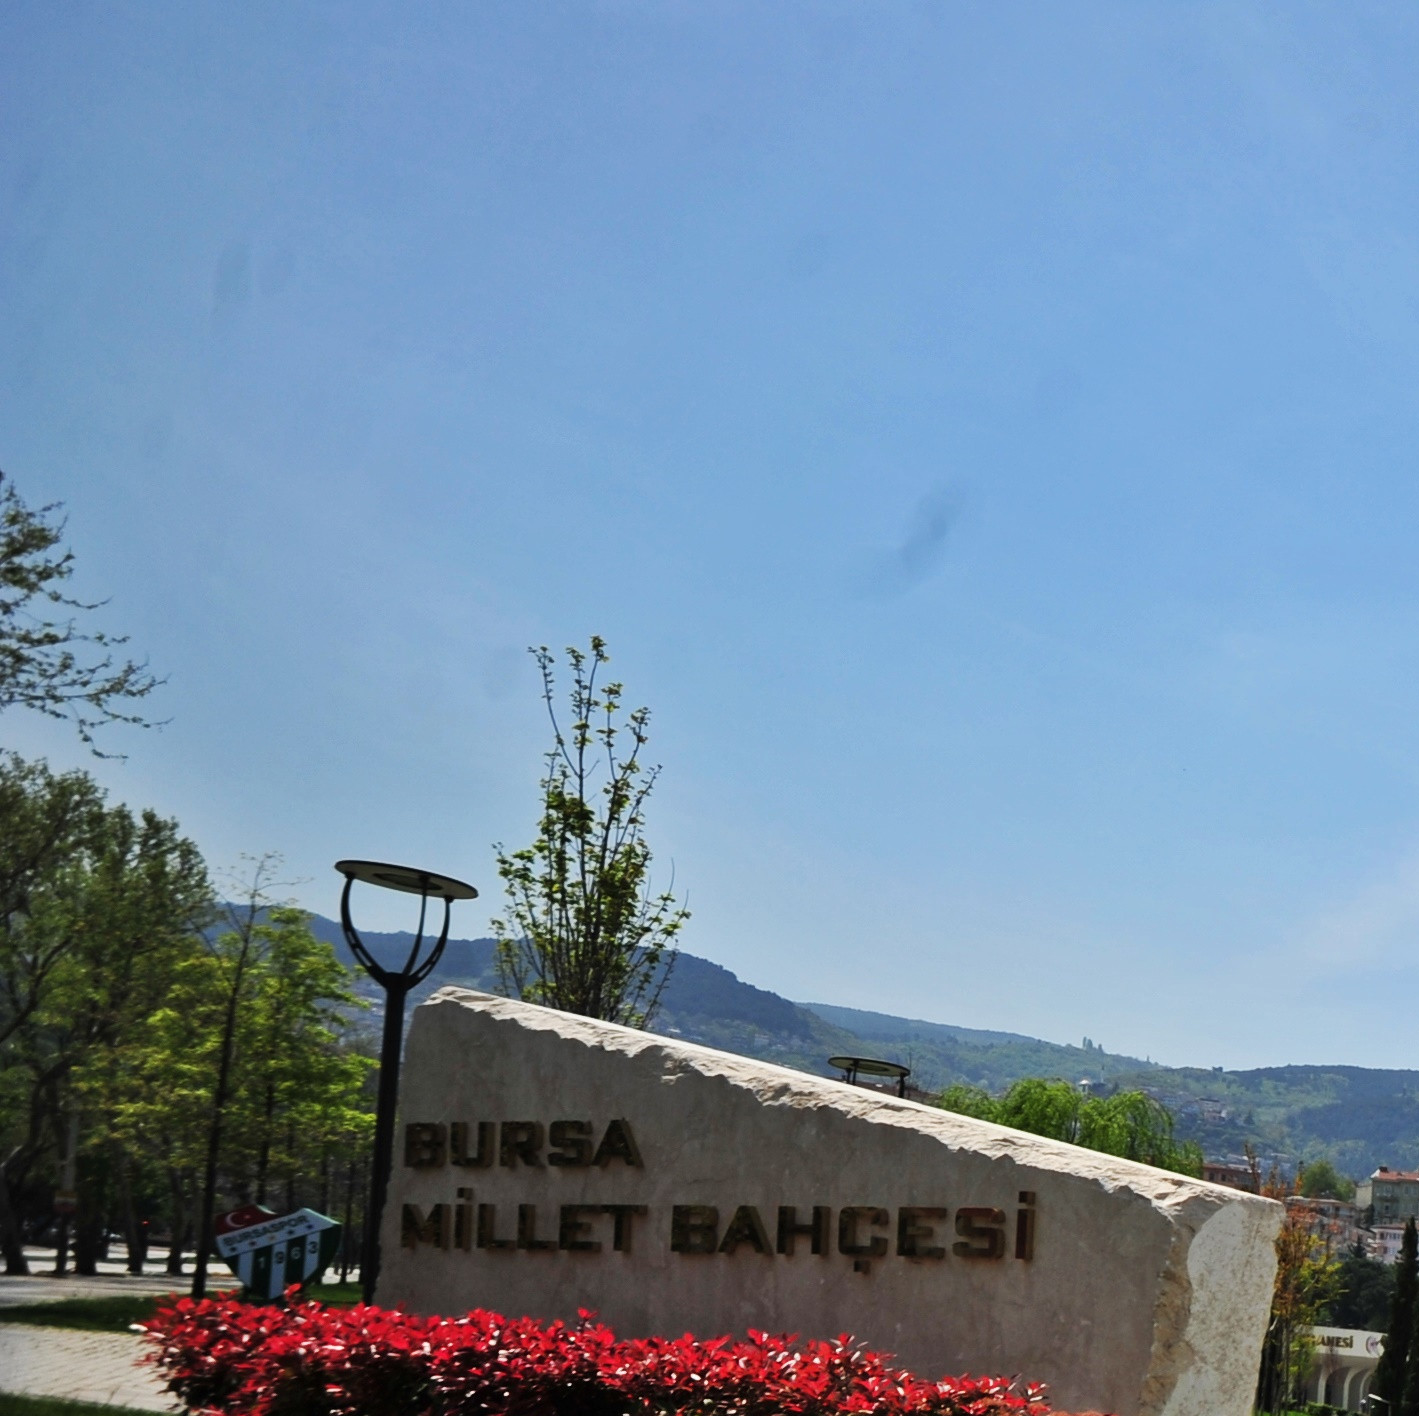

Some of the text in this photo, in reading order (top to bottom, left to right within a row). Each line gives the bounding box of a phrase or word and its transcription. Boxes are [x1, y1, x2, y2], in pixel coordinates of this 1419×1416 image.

[403, 1118, 643, 1169] BURSA
[223, 1215, 309, 1247] BURSASPOR
[401, 1187, 1037, 1275] MİLLET BAHÇESİ
